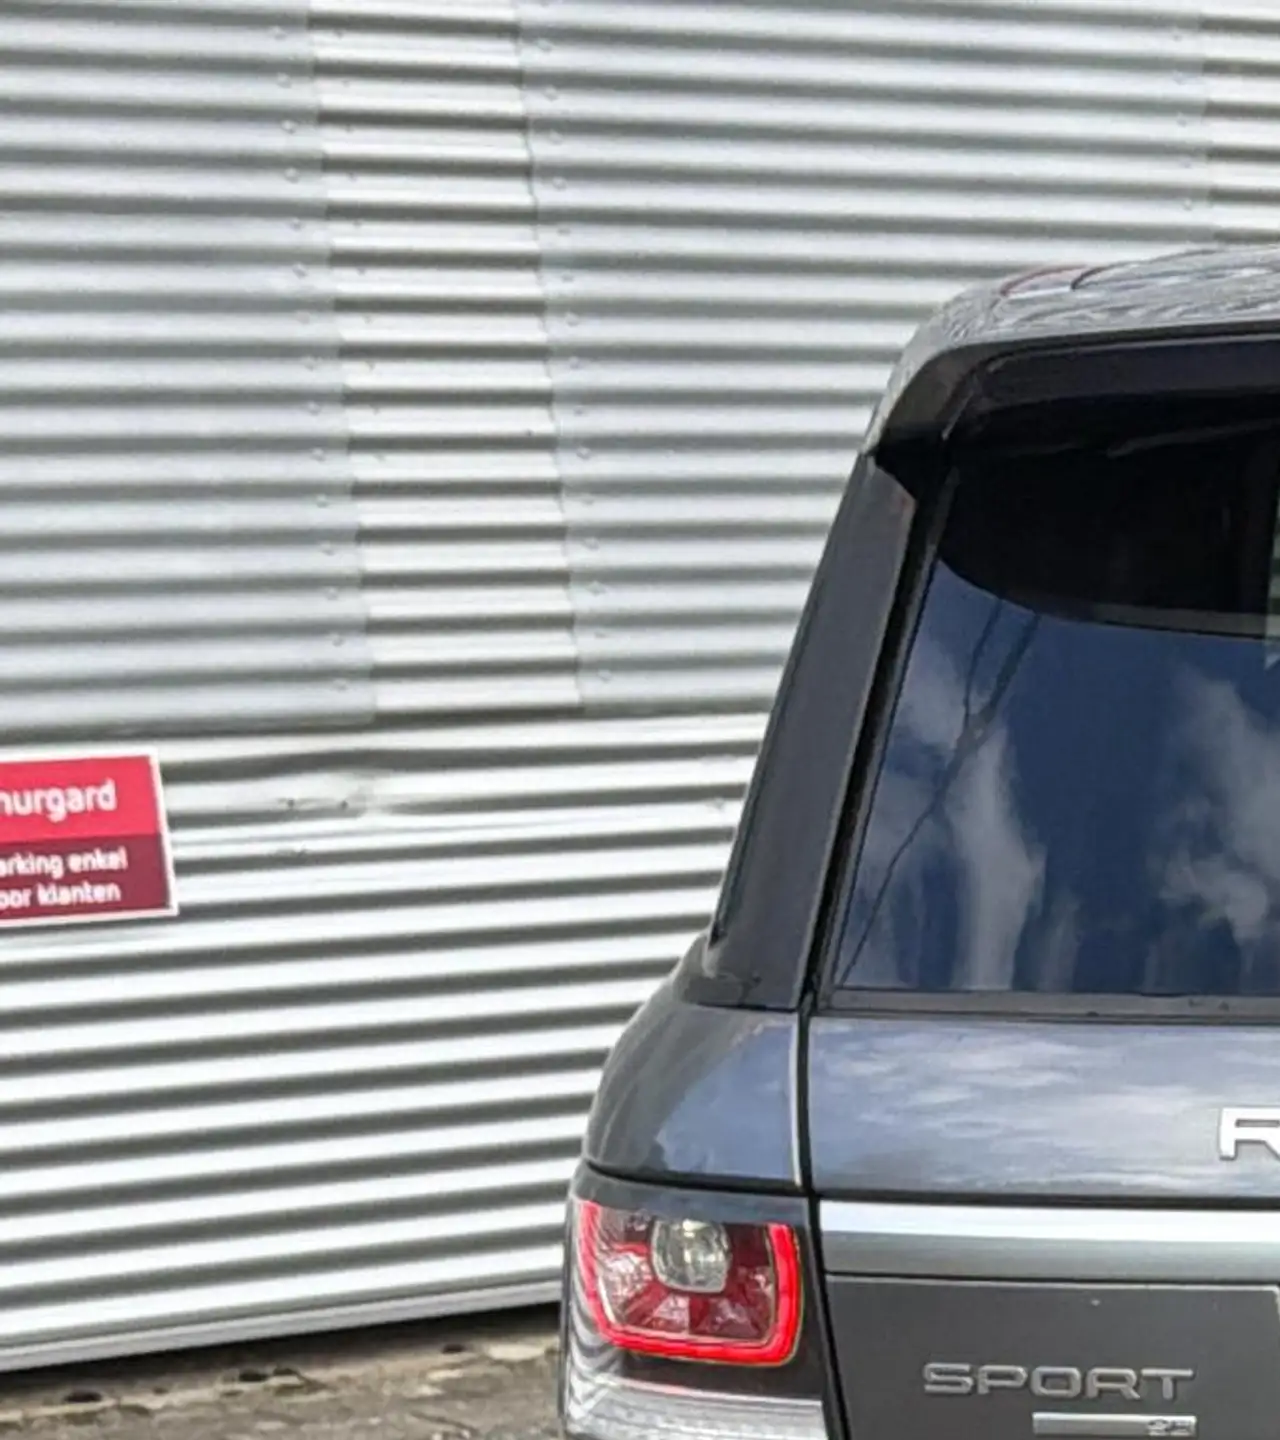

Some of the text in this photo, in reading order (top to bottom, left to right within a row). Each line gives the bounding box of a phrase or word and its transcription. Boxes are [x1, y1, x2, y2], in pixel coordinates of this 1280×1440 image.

[68, 845, 128, 872] enkel
[37, 880, 122, 907] klanten
[923, 1362, 1194, 1400] SPORT
